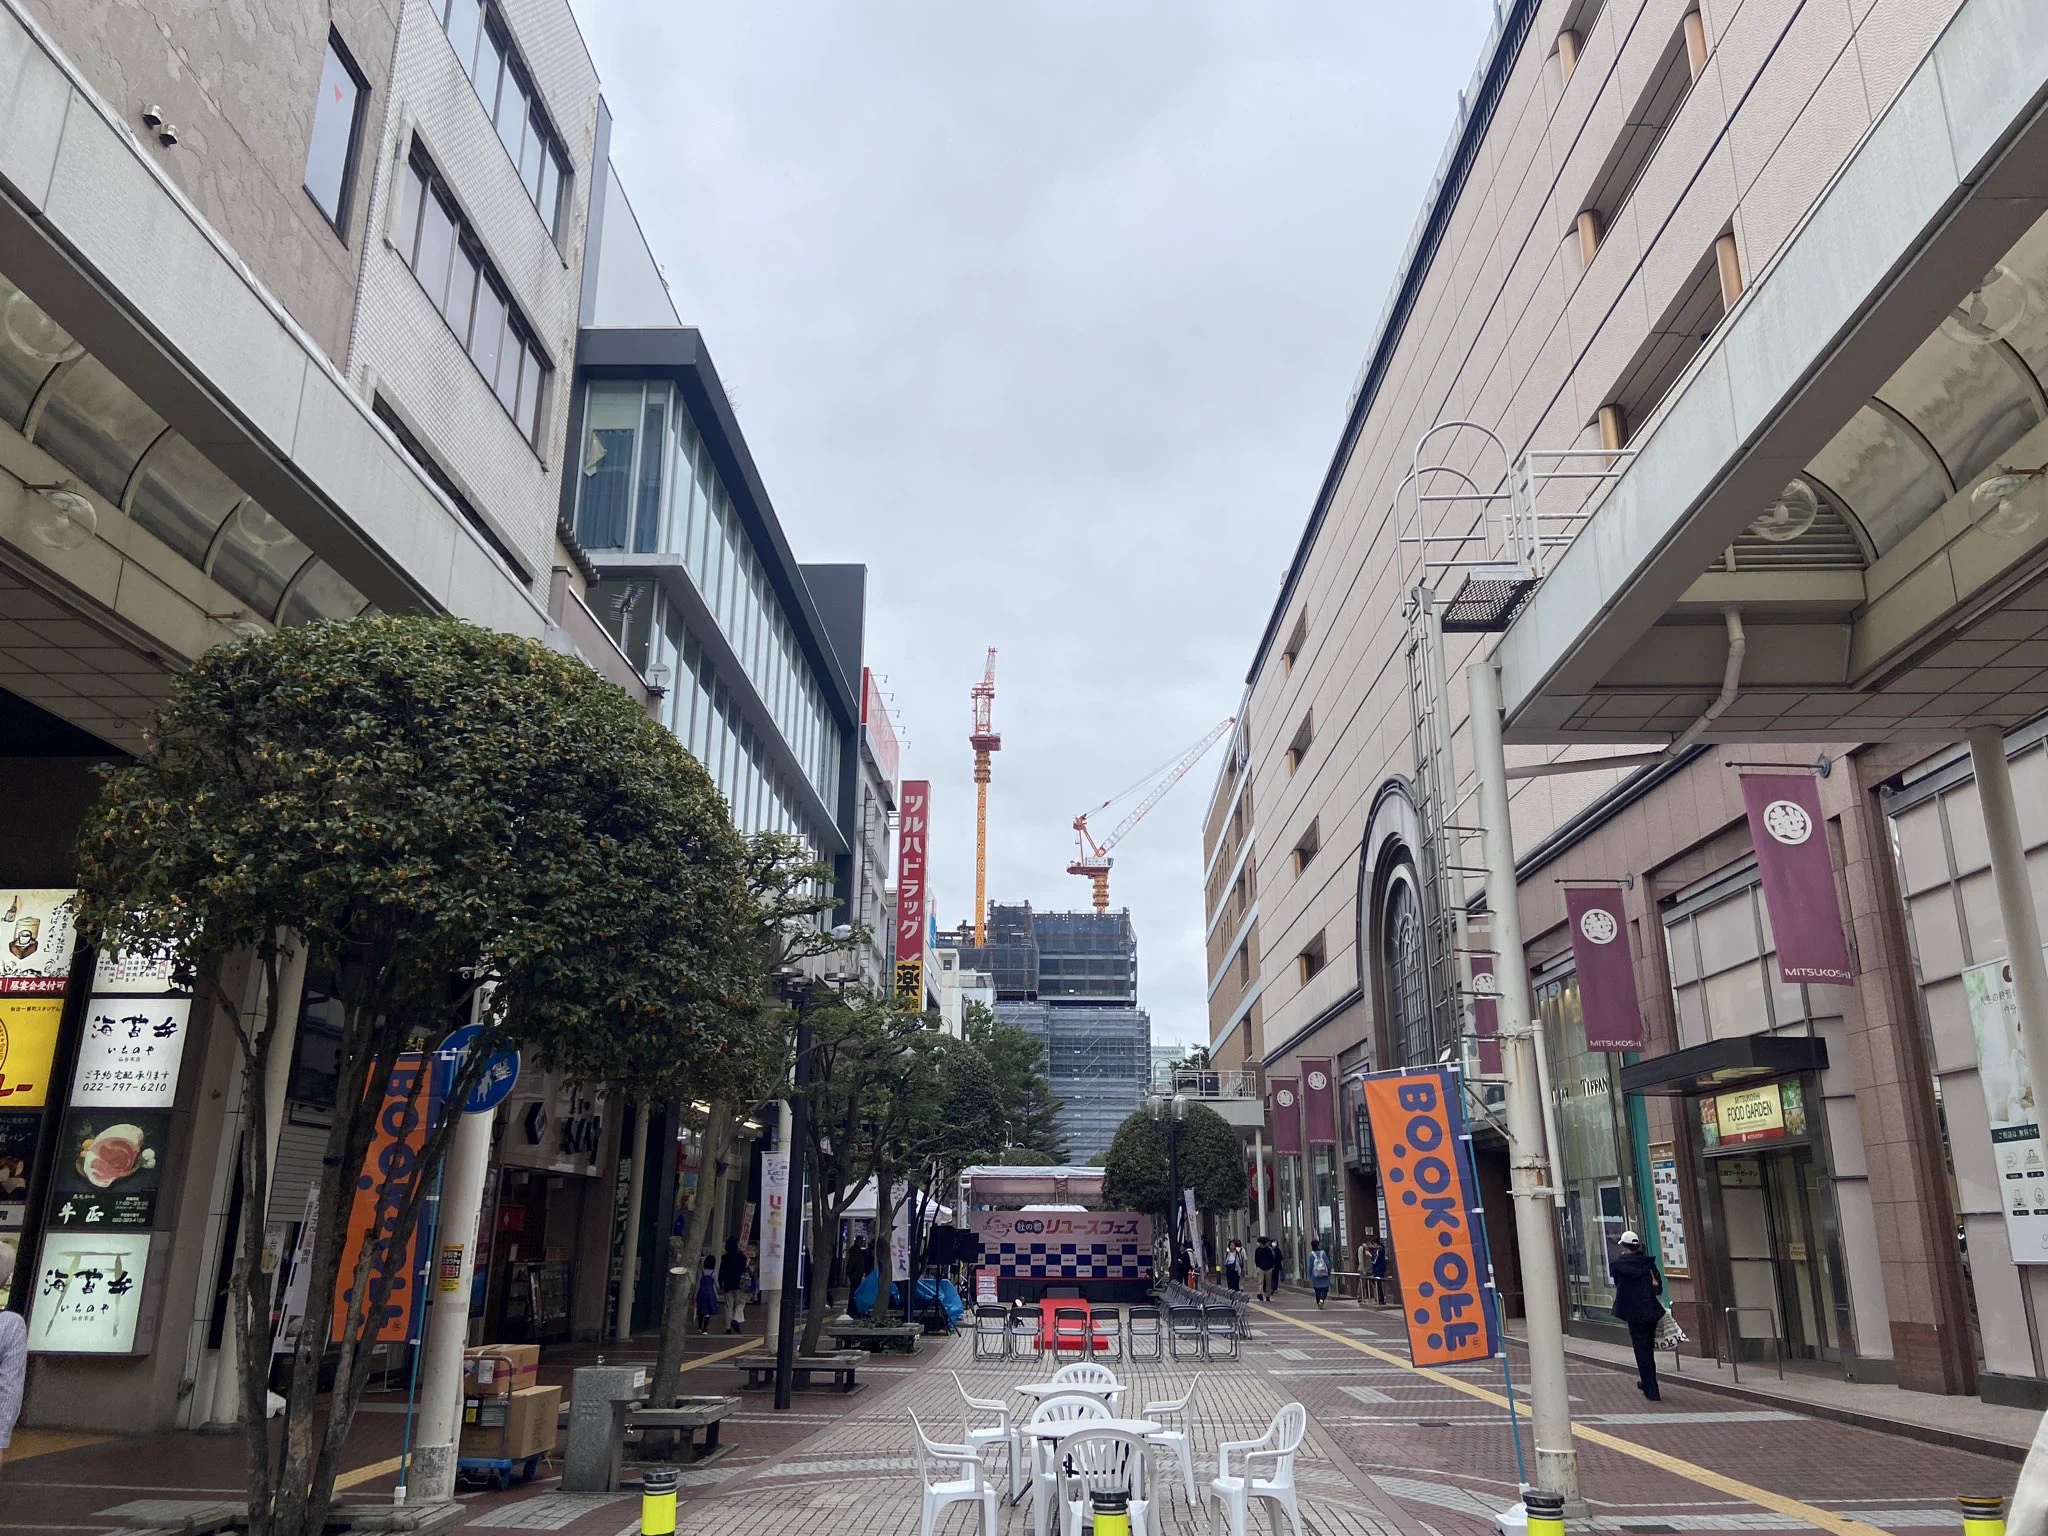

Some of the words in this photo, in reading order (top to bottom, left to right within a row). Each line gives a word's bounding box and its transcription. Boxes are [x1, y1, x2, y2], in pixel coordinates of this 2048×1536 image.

[900, 795, 924, 939] ツルハドラッグ
[1784, 967, 1851, 980] MITSUKOSHI
[10, 980, 66, 991] 昼宴会受付可
[896, 964, 920, 997] 薬
[91, 1014, 178, 1039] 海苔弁
[1590, 1039, 1642, 1048] MITSUKOSHI
[107, 1045, 155, 1056] いちのや
[84, 1070, 112, 1081] ご予約
[135, 1070, 170, 1081] 承ります
[82, 1082, 167, 1093] 022-797-6210
[1727, 1105, 1745, 1122] FOOD
[1745, 1100, 1773, 1119] GARDEN
[1017, 1220, 1043, 1233] 杜の都
[1045, 1219, 1139, 1235] リユースフェス
[43, 1267, 134, 1296] 海苔弁
[60, 1302, 109, 1315] いちのや
